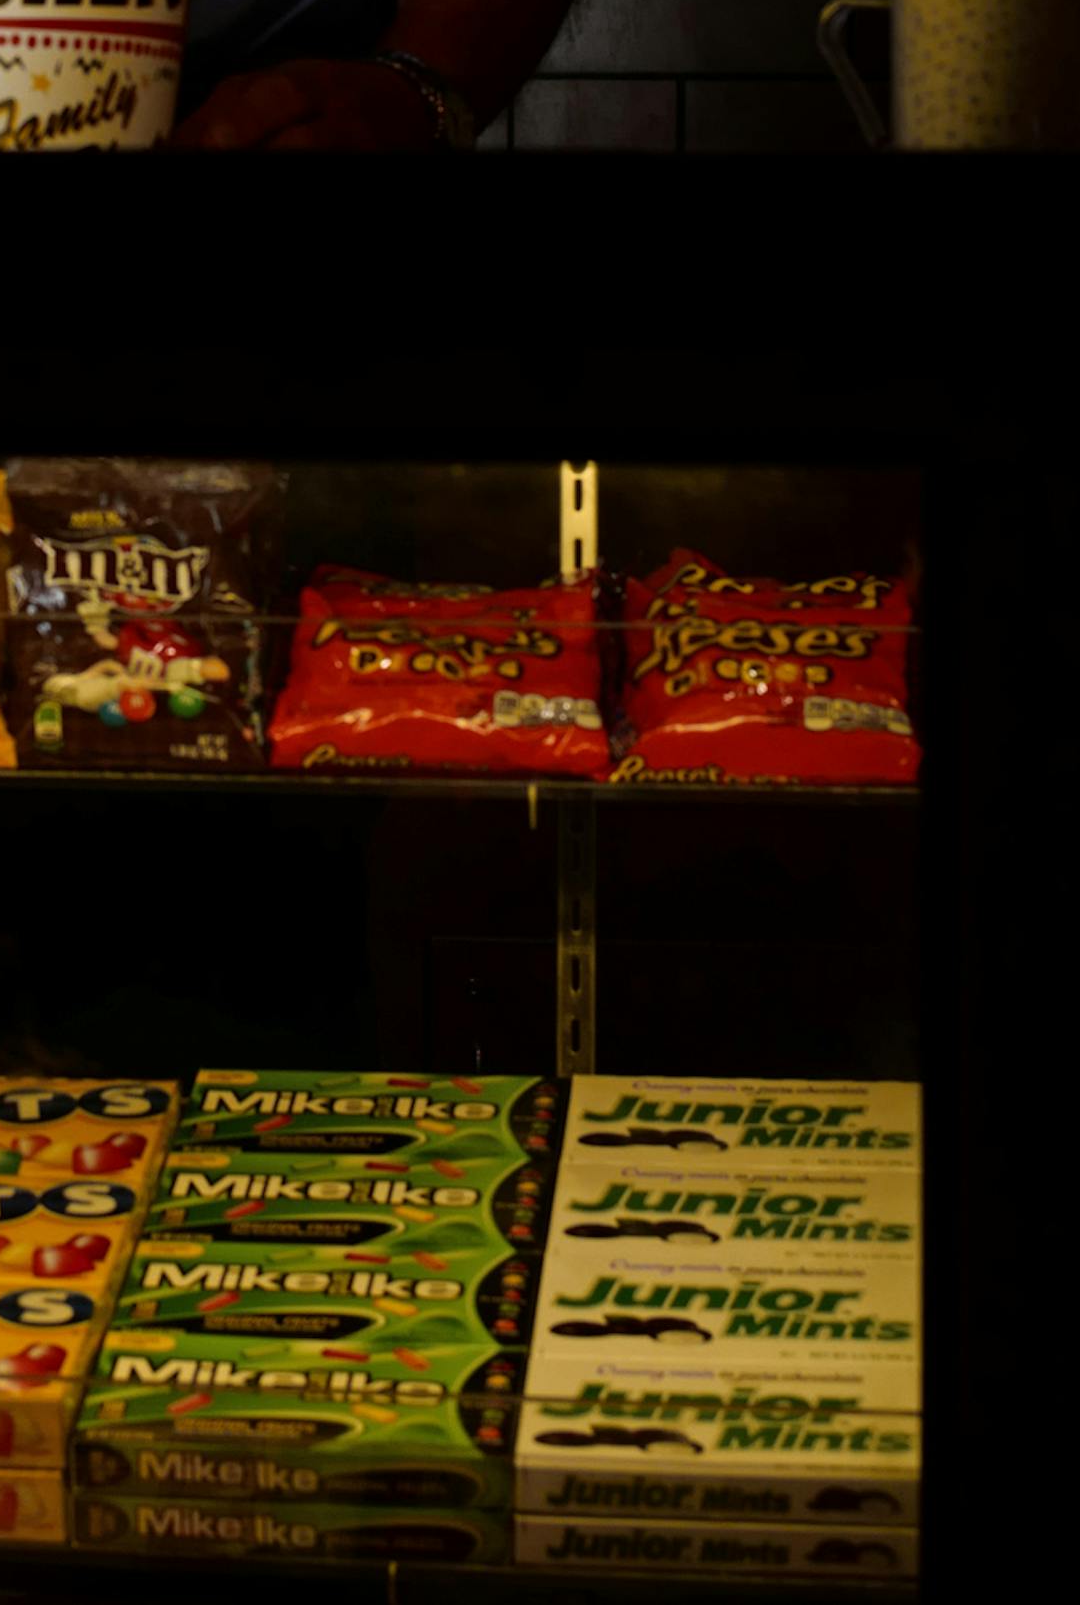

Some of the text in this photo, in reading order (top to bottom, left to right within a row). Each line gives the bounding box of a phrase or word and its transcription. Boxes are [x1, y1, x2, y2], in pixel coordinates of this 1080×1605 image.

[200, 1088, 499, 1121] Mike Ike
[582, 1094, 865, 1127] Junior
[739, 1127, 912, 1149] Mints
[170, 1171, 481, 1208] Mike Ike
[568, 1183, 863, 1217] Junior
[731, 1217, 912, 1242] Mints
[140, 1260, 465, 1300] Mike Ike
[554, 1276, 861, 1313] Junior
[725, 1313, 913, 1341] Mints
[111, 1355, 447, 1407] Mike Ike
[539, 1383, 859, 1425] Junior
[716, 1425, 913, 1453] Mints
[136, 1450, 245, 1484] Mike
[256, 1461, 319, 1493] Ike
[545, 1474, 792, 1513] Junior Mints
[545, 1527, 792, 1564] Junior Mints
